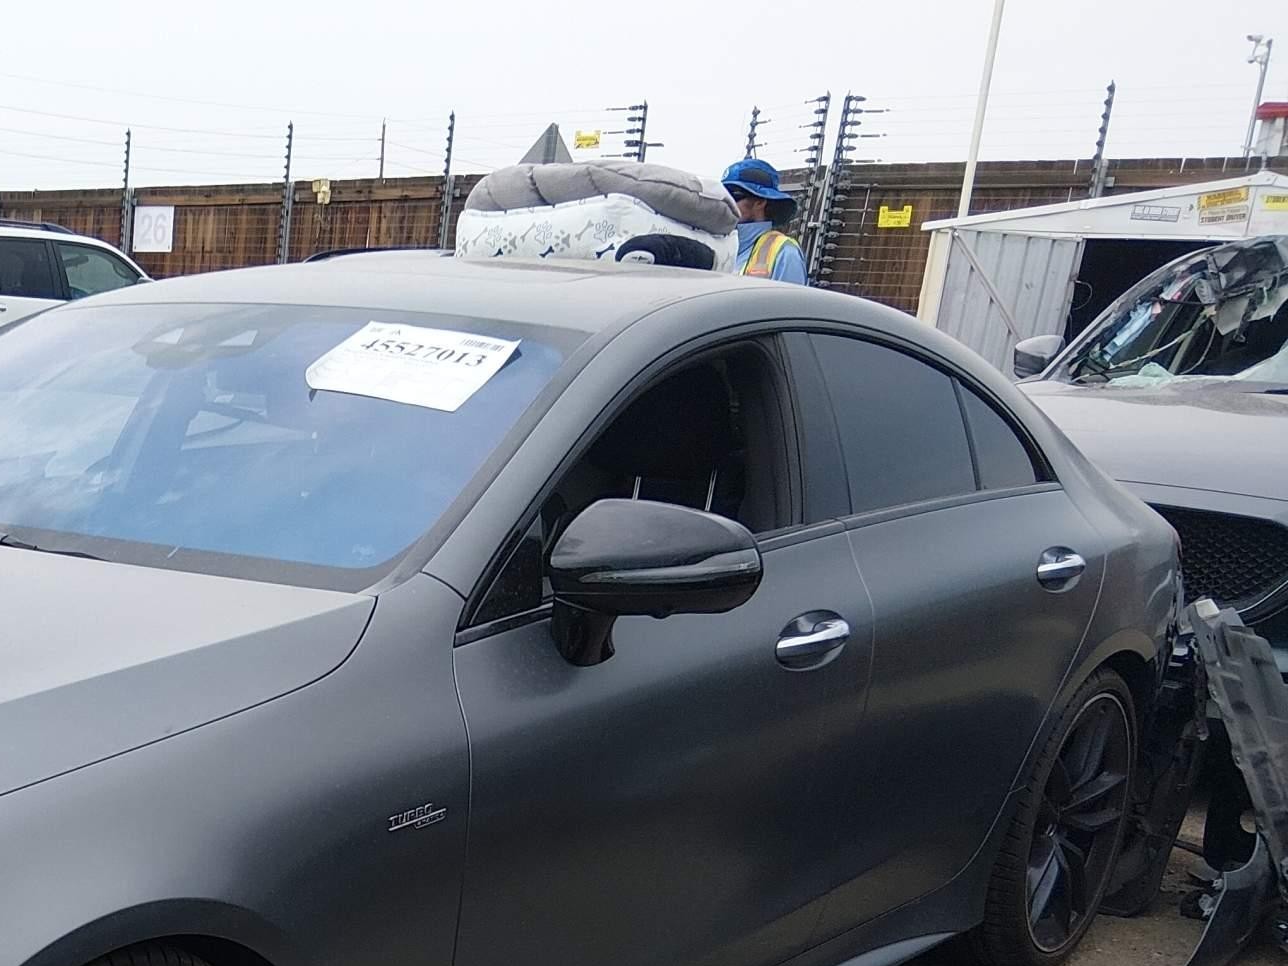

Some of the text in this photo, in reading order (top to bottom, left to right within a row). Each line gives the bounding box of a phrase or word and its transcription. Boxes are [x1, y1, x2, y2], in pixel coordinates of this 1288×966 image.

[141, 213, 166, 244] 26
[361, 339, 488, 367] 45527013
[388, 803, 432, 827] TURBO
